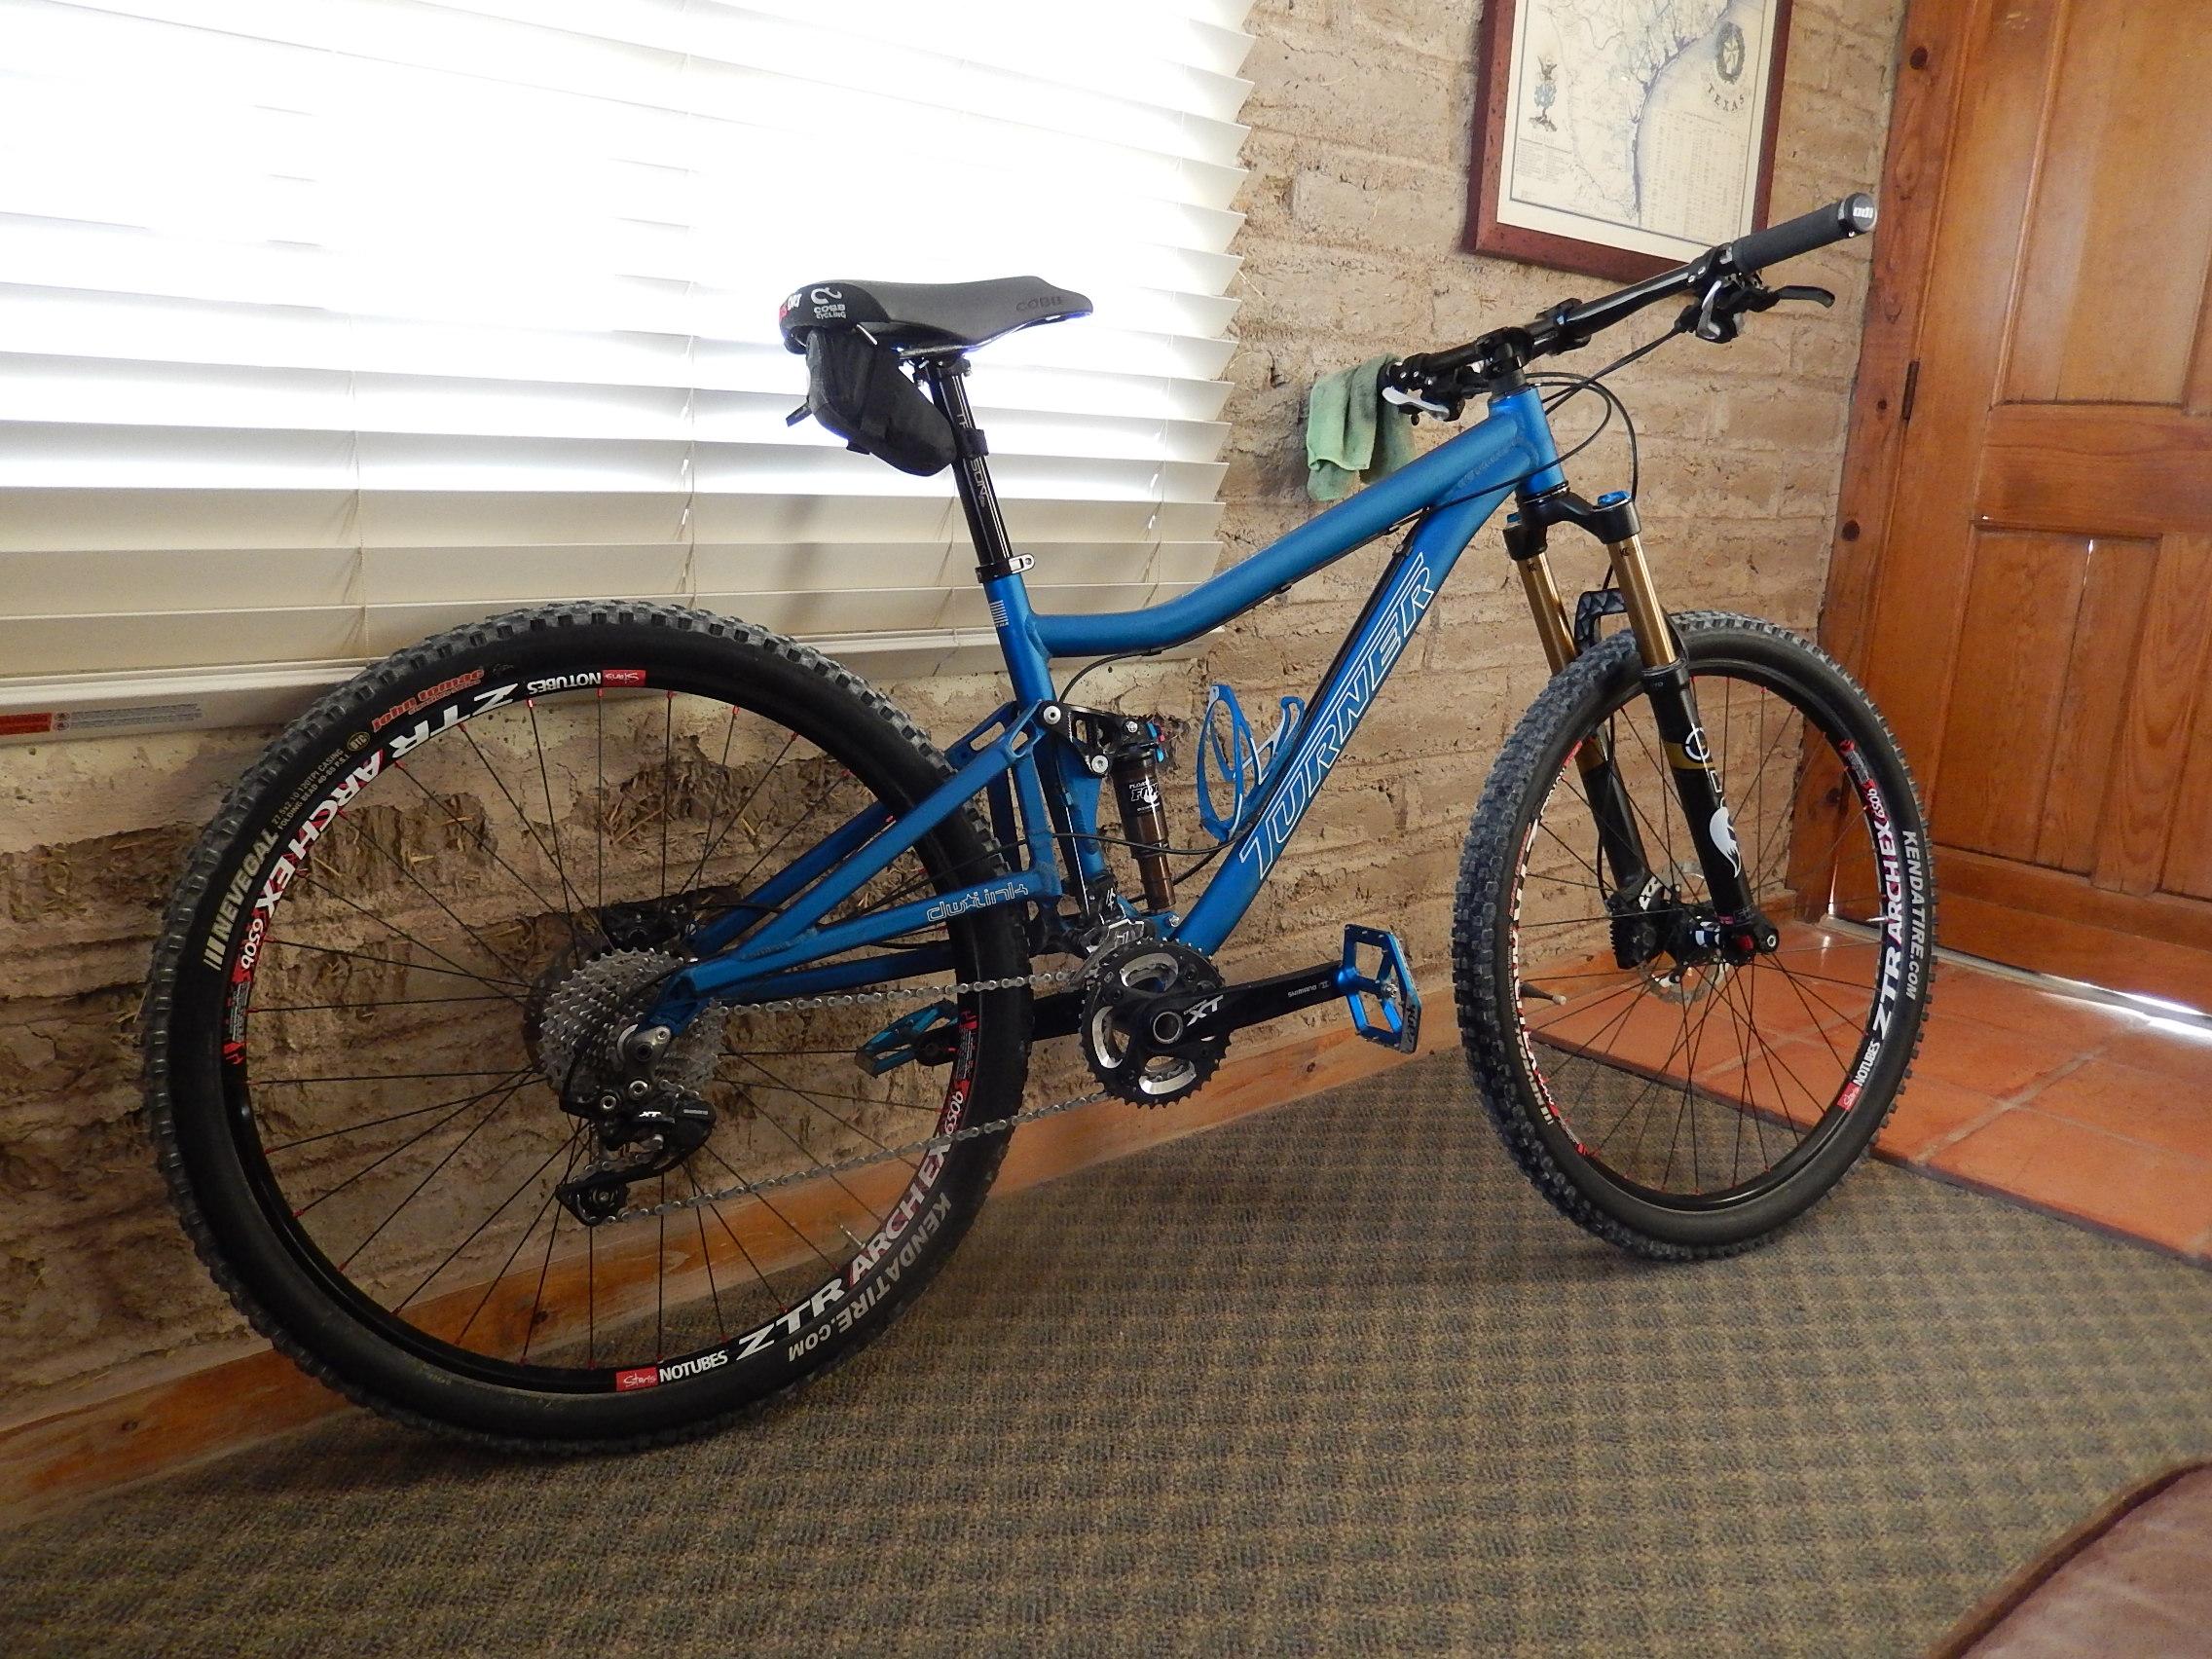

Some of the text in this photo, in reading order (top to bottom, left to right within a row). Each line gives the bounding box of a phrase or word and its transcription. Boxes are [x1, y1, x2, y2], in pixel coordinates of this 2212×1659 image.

[1708, 83, 1745, 112] TEXAS
[389, 682, 519, 758] ZTR
[527, 672, 602, 695] NOTUBES
[1239, 551, 1436, 880] TURNER
[317, 748, 345, 772] CASING
[210, 829, 279, 942] NEVEGAL
[1902, 830, 1926, 1001] KENDATIRE.COM
[1186, 994, 1224, 1027] XT
[1287, 984, 1317, 998] SHIMANO
[1872, 946, 1902, 1041] ZTR
[1853, 1039, 1881, 1087] NOTUBES
[789, 1192, 952, 1362] KENDATIRE.COM
[659, 1349, 728, 1382] NOTUBES
[736, 1277, 845, 1361] ZTR
